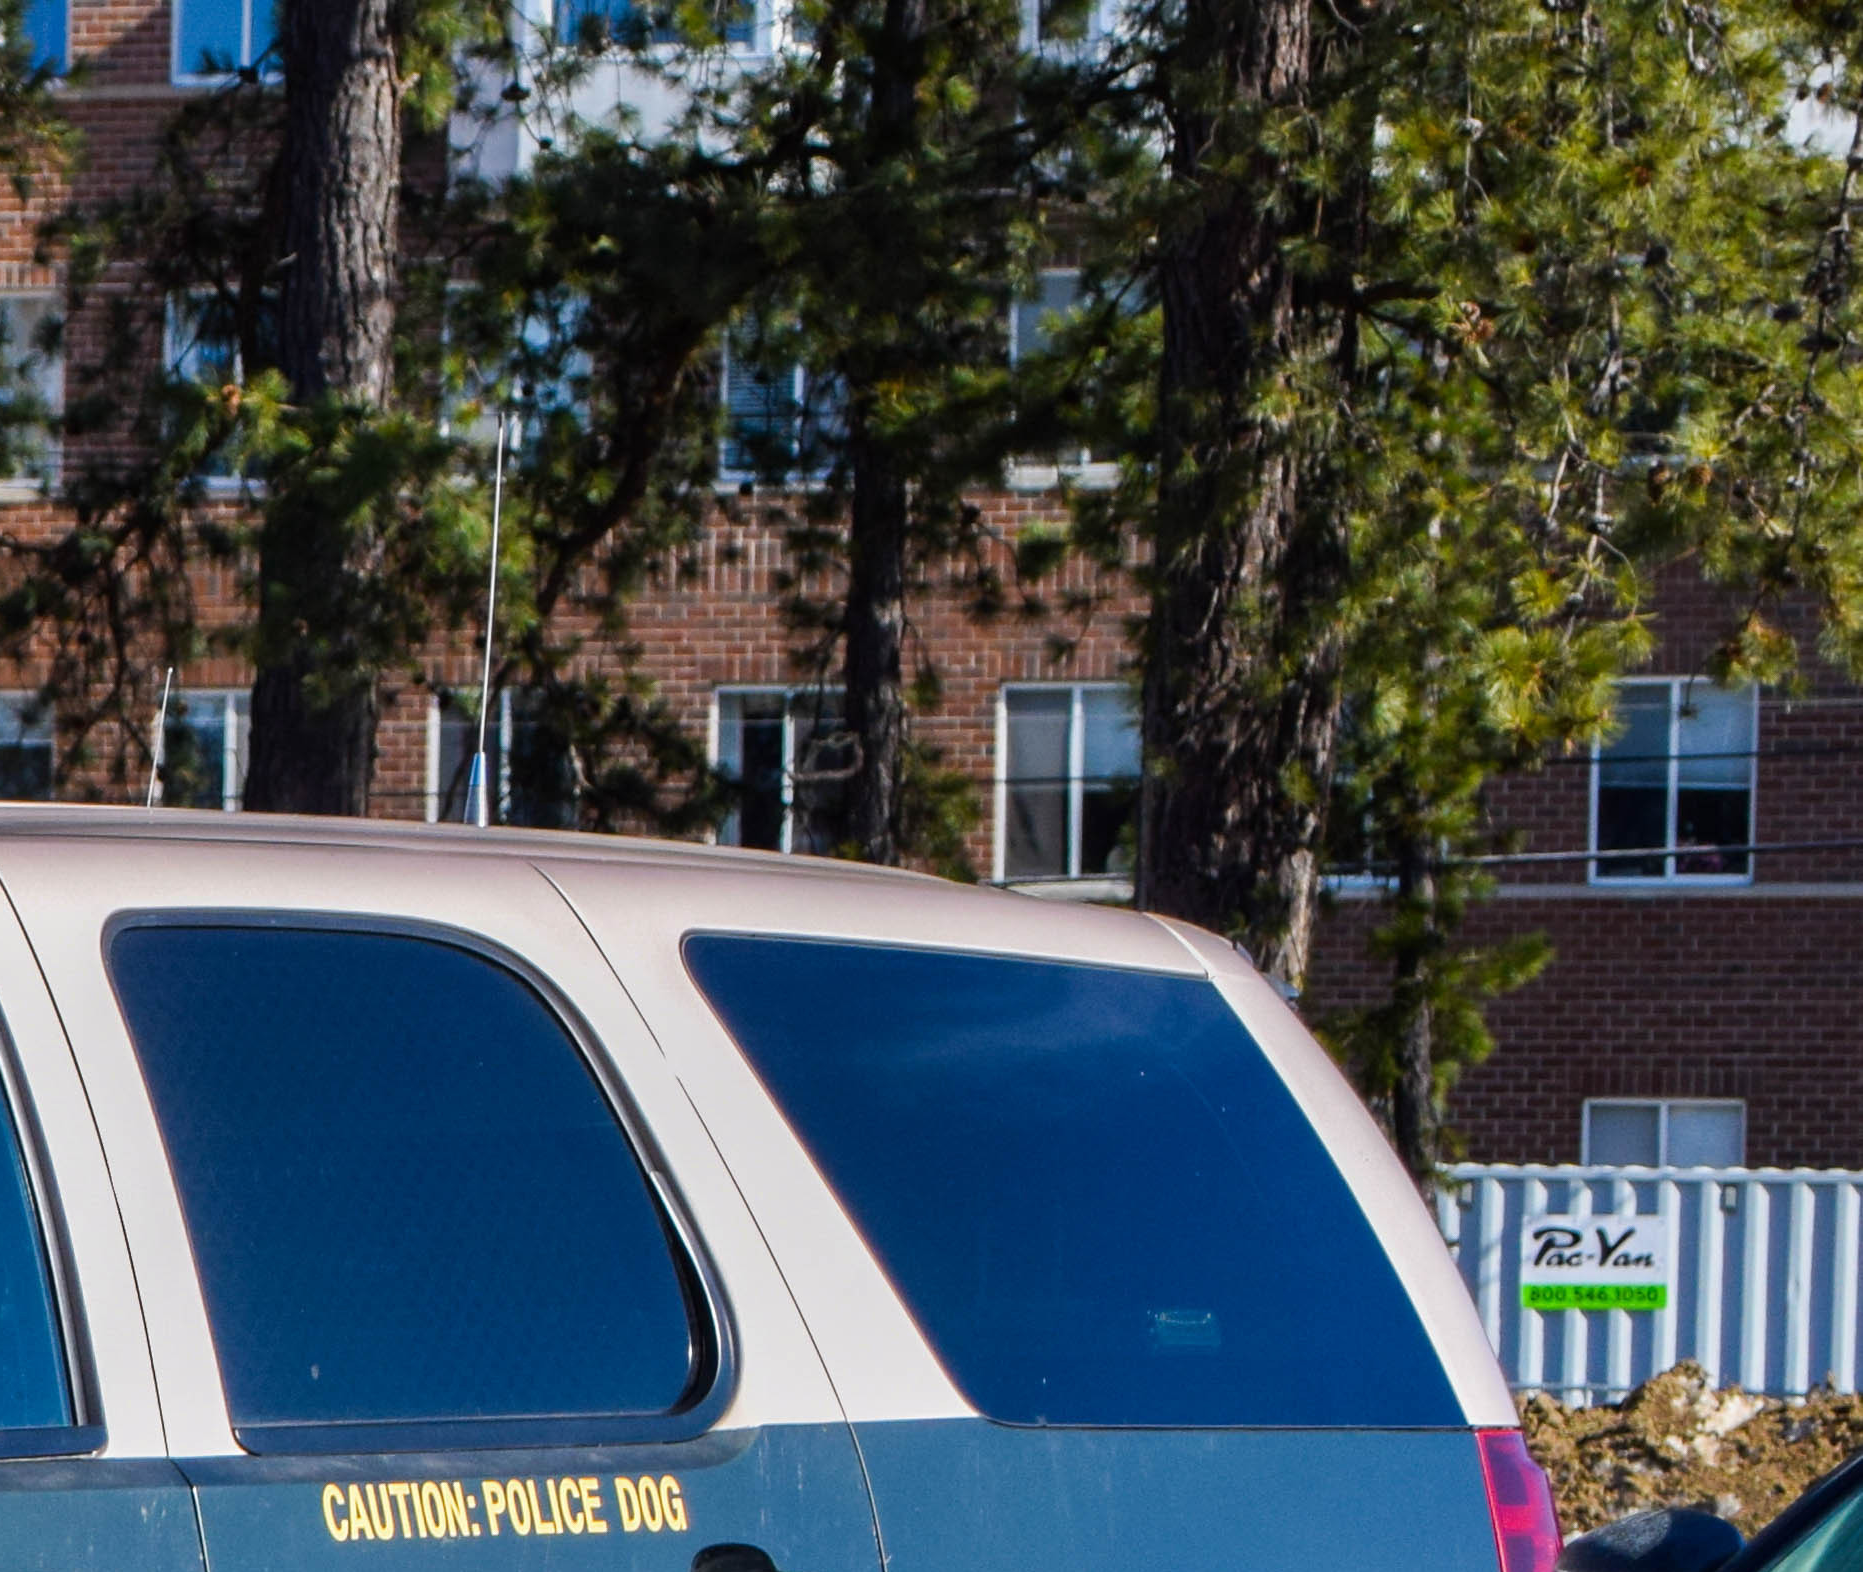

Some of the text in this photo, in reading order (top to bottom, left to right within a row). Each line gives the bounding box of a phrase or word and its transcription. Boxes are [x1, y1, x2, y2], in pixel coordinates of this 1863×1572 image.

[322, 1475, 688, 1542] CAUTION: POLICE DOG
